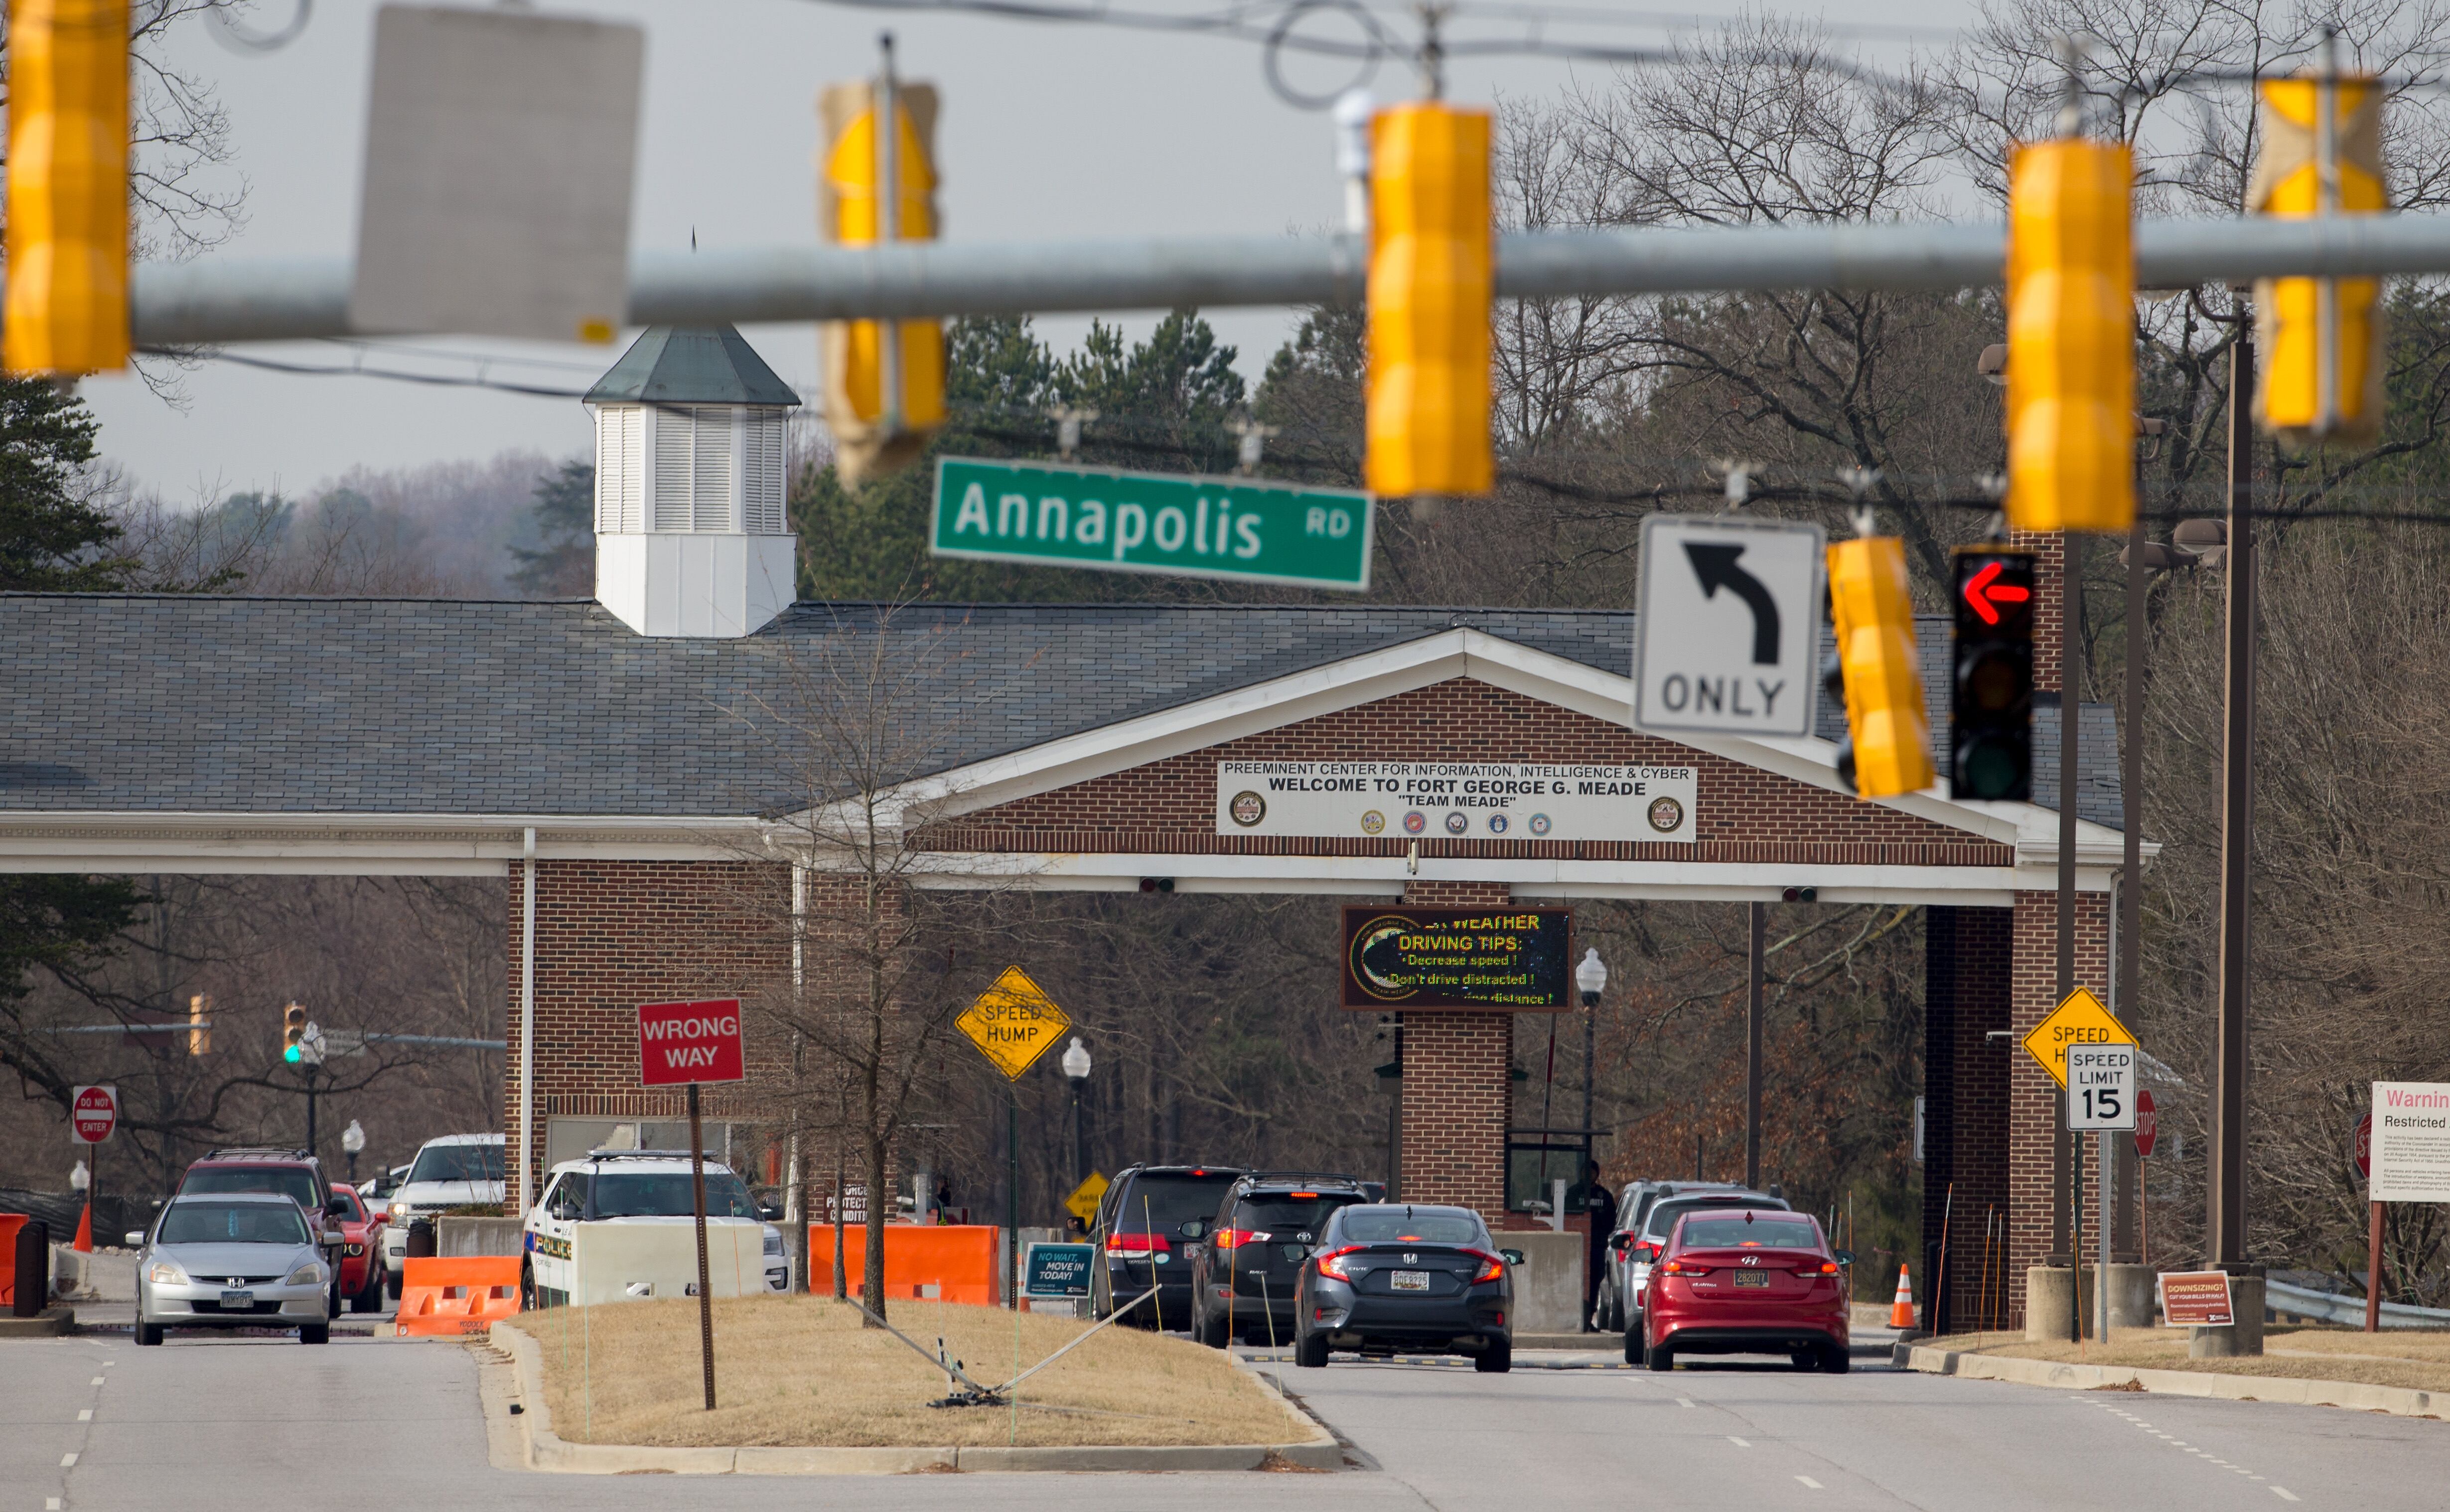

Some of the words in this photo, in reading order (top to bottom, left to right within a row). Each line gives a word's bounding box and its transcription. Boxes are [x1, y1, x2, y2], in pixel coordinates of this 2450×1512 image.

[954, 481, 1263, 561] Annapolis
[1305, 506, 1352, 539] RD
[1661, 673, 1784, 717] ONLY
[1225, 763, 1316, 774] PREEMINENT
[1320, 763, 1377, 775] CENTER
[1382, 764, 1410, 775] FOR
[1415, 765, 1516, 778] INFORMATION,
[1521, 766, 1622, 778] INTELLIGENCE
[1627, 768, 1636, 778] &
[1641, 768, 1689, 779] CYBER
[1269, 778, 1367, 792] WELCOME
[1374, 779, 1400, 793] TO
[1407, 779, 1457, 793] FORT
[1463, 780, 1545, 795] GEORGE
[1552, 781, 1571, 795] G.
[1579, 782, 1646, 796] MEADE
[1398, 795, 1449, 806] "TEAM
[1454, 797, 1516, 808] MEADE"
[1399, 935, 1473, 952] DRIVING
[1477, 935, 1522, 952] TIPS:
[1469, 955, 1509, 968] speed
[1427, 973, 1459, 985] drive
[1462, 973, 1527, 985] distracted
[985, 1005, 1041, 1021] SPEED
[642, 1016, 737, 1041] WRONG
[987, 1027, 1038, 1042] HUMP
[2053, 1026, 2109, 1043] SPEED
[665, 1046, 718, 1068] WAY
[2073, 1054, 2130, 1067] SPEED
[2079, 1072, 2123, 1084] LIMIT
[81, 1098, 91, 1107] DO
[95, 1098, 109, 1107] NOT
[2082, 1089, 2121, 1119] 15
[83, 1122, 107, 1132] ENTER
[2136, 1111, 2155, 1136] STOP
[2385, 1115, 2446, 1128] Restricted
[843, 1184, 867, 1196] ORCE
[536, 1236, 572, 1258] POLICE
[1038, 1252, 1053, 1261] NO
[1053, 1253, 1078, 1263] WAIT,
[1046, 1262, 1074, 1271] MOVE
[1074, 1263, 1085, 1271] IN
[1039, 1271, 1073, 1280] TODAY!
[1737, 1273, 1765, 1283] 282077
[2167, 1284, 2224, 1293] DOWNSIZING?
